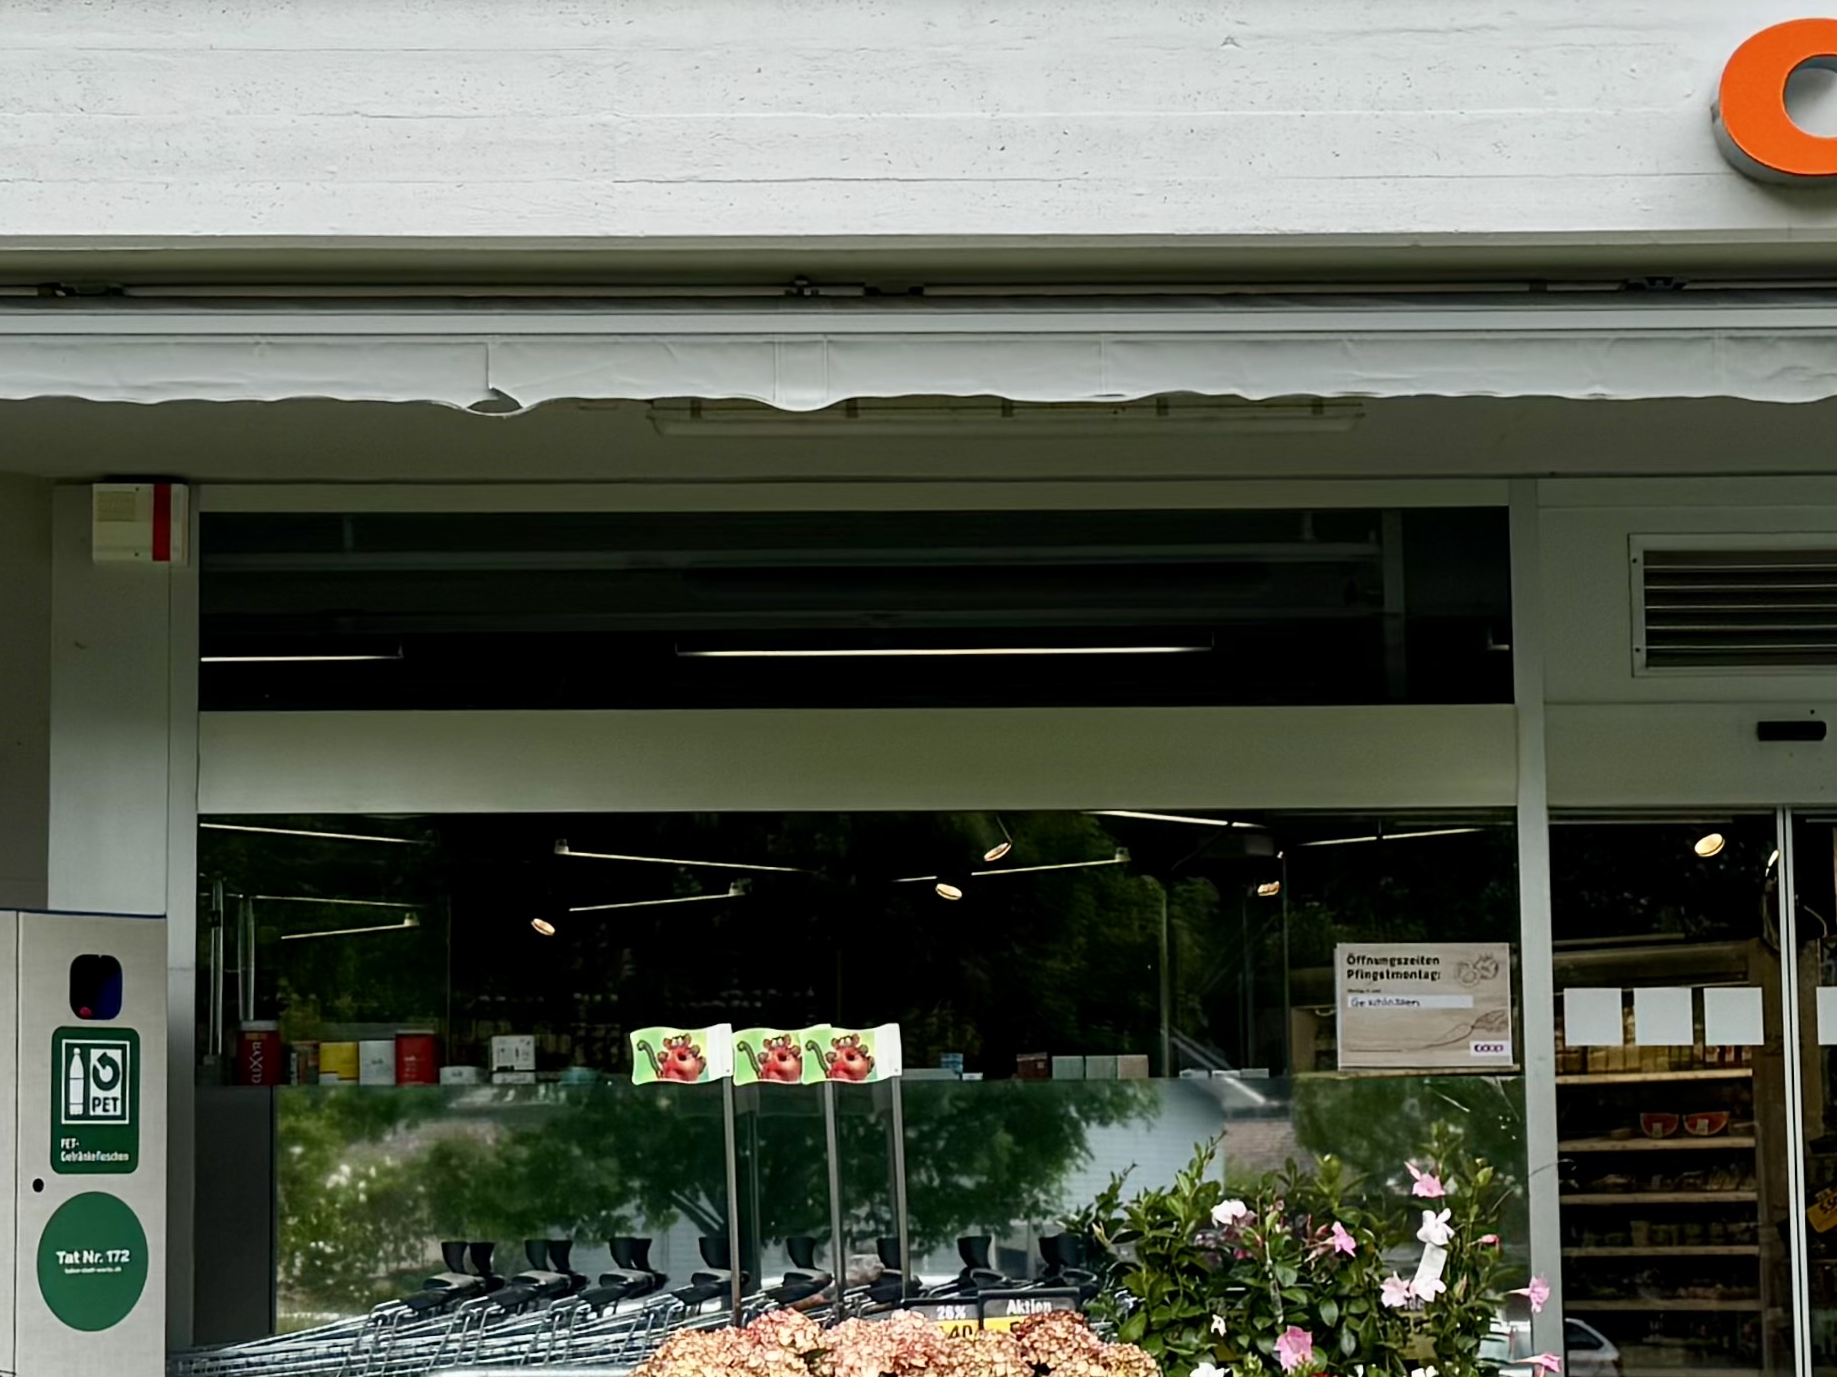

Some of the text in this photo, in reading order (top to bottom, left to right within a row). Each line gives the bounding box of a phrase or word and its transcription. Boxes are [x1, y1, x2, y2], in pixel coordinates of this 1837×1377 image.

[1346, 953, 1440, 966] Öffnungszeiten
[1346, 969, 1441, 982] Pfingstmontag:
[92, 1097, 119, 1113] PET
[56, 1250, 131, 1264] Tat Nr. 172
[1006, 1299, 1052, 1316] Aktion
